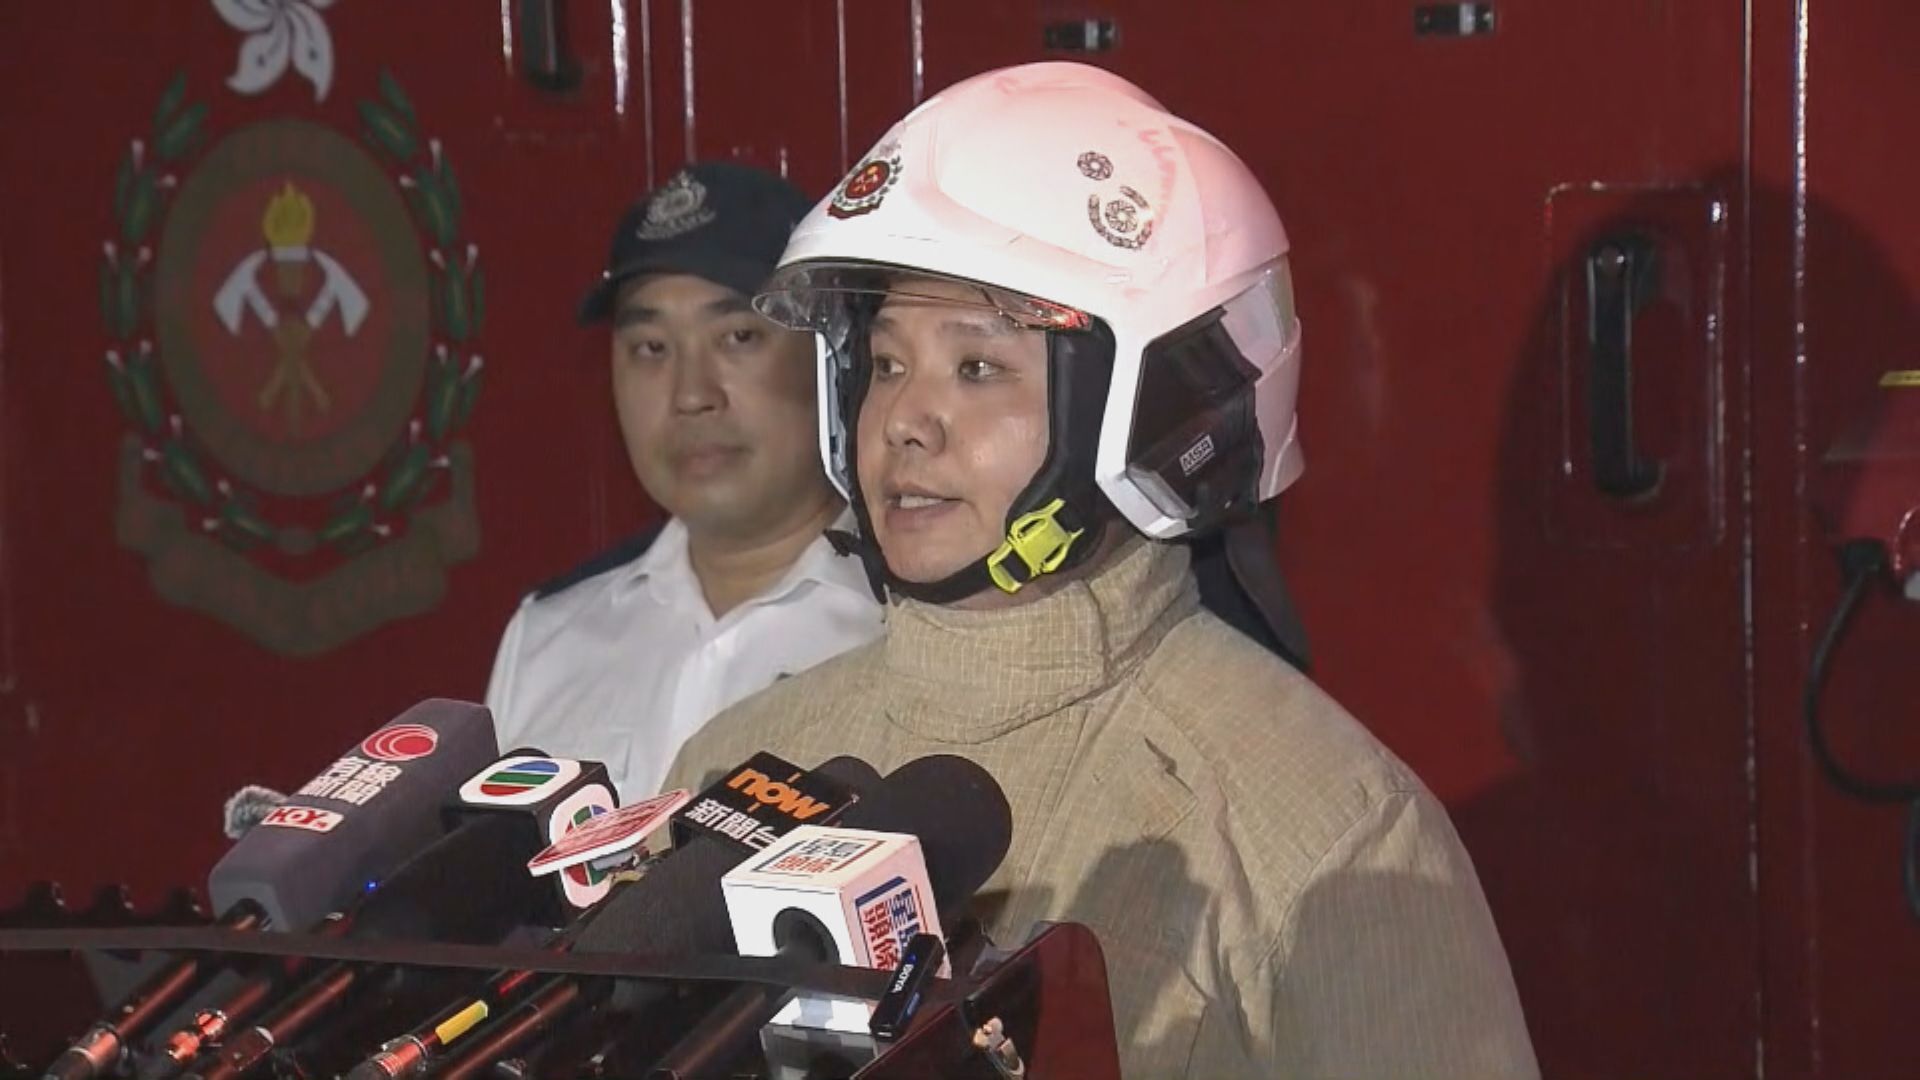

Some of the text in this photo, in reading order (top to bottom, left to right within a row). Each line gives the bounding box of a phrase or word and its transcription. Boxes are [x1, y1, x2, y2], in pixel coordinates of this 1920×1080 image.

[298, 776, 381, 805] 新聞
[726, 768, 831, 820] now
[685, 798, 778, 850] 新聞台
